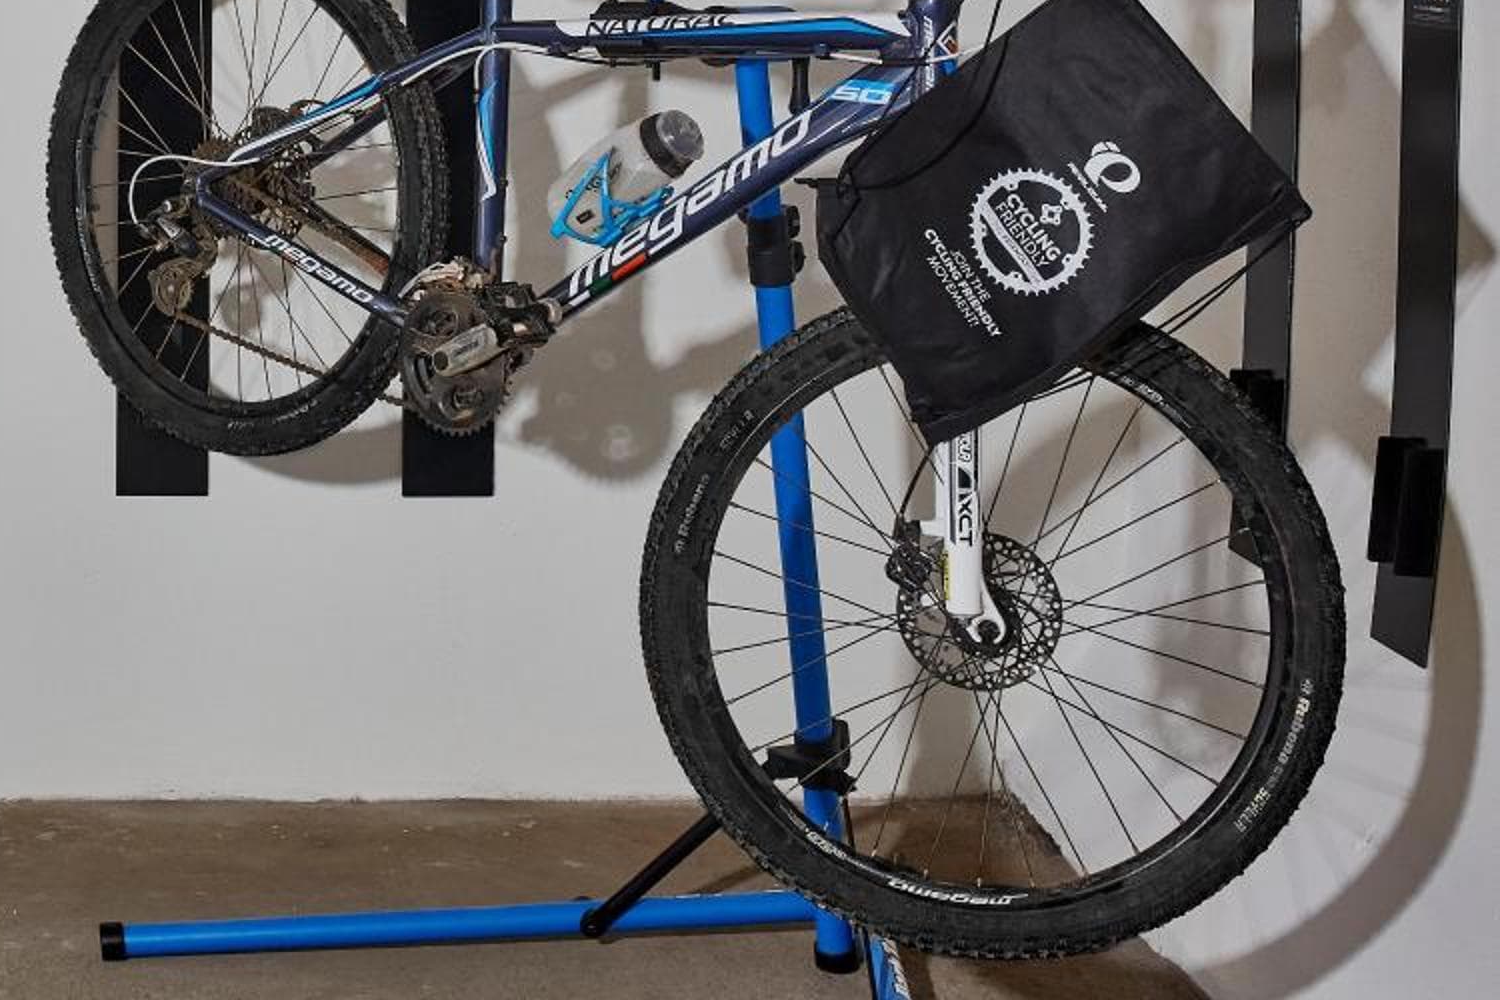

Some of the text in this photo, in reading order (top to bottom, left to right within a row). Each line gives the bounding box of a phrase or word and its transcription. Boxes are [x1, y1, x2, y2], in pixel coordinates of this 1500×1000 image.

[569, 110, 813, 299] megamo
[995, 202, 1050, 268] FRIENDLY
[1006, 193, 1062, 262] CYCLING
[264, 234, 375, 303] megamo
[923, 228, 1003, 338] CYCLING FRIENDLY
[926, 255, 980, 328] MOVEMENT!
[949, 249, 992, 303] JOIN THE
[957, 498, 974, 547] XCT
